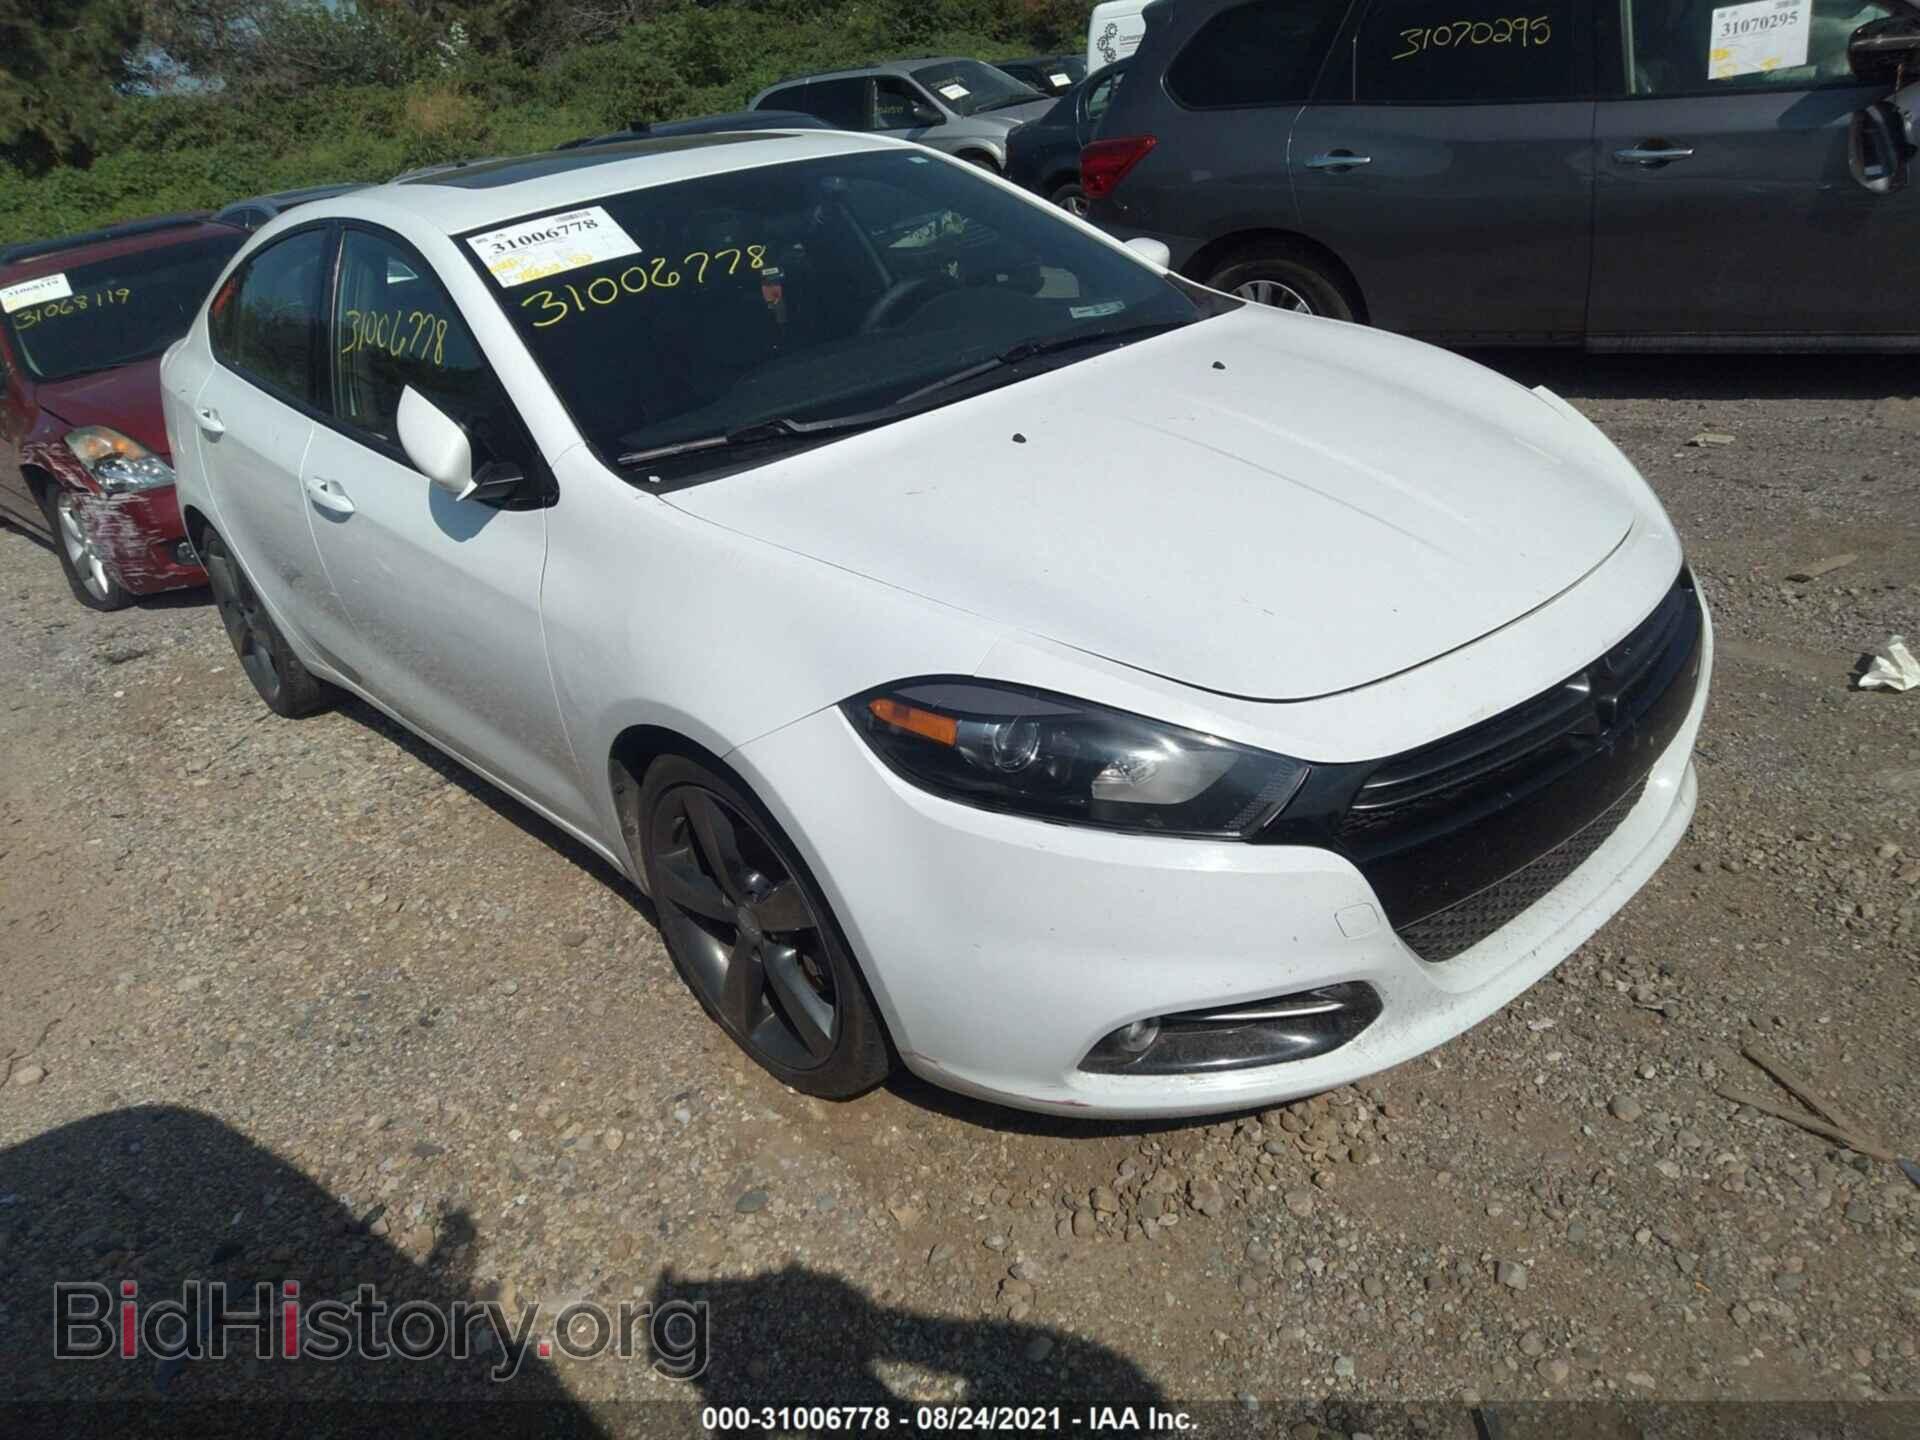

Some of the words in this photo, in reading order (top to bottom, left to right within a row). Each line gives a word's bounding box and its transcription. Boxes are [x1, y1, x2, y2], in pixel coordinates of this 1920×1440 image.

[1392, 16, 1551, 60] 31070295
[1720, 10, 1799, 37] 31070295
[491, 219, 598, 255] 31006778
[521, 244, 766, 327] 31006778
[15, 287, 131, 330] 31068119
